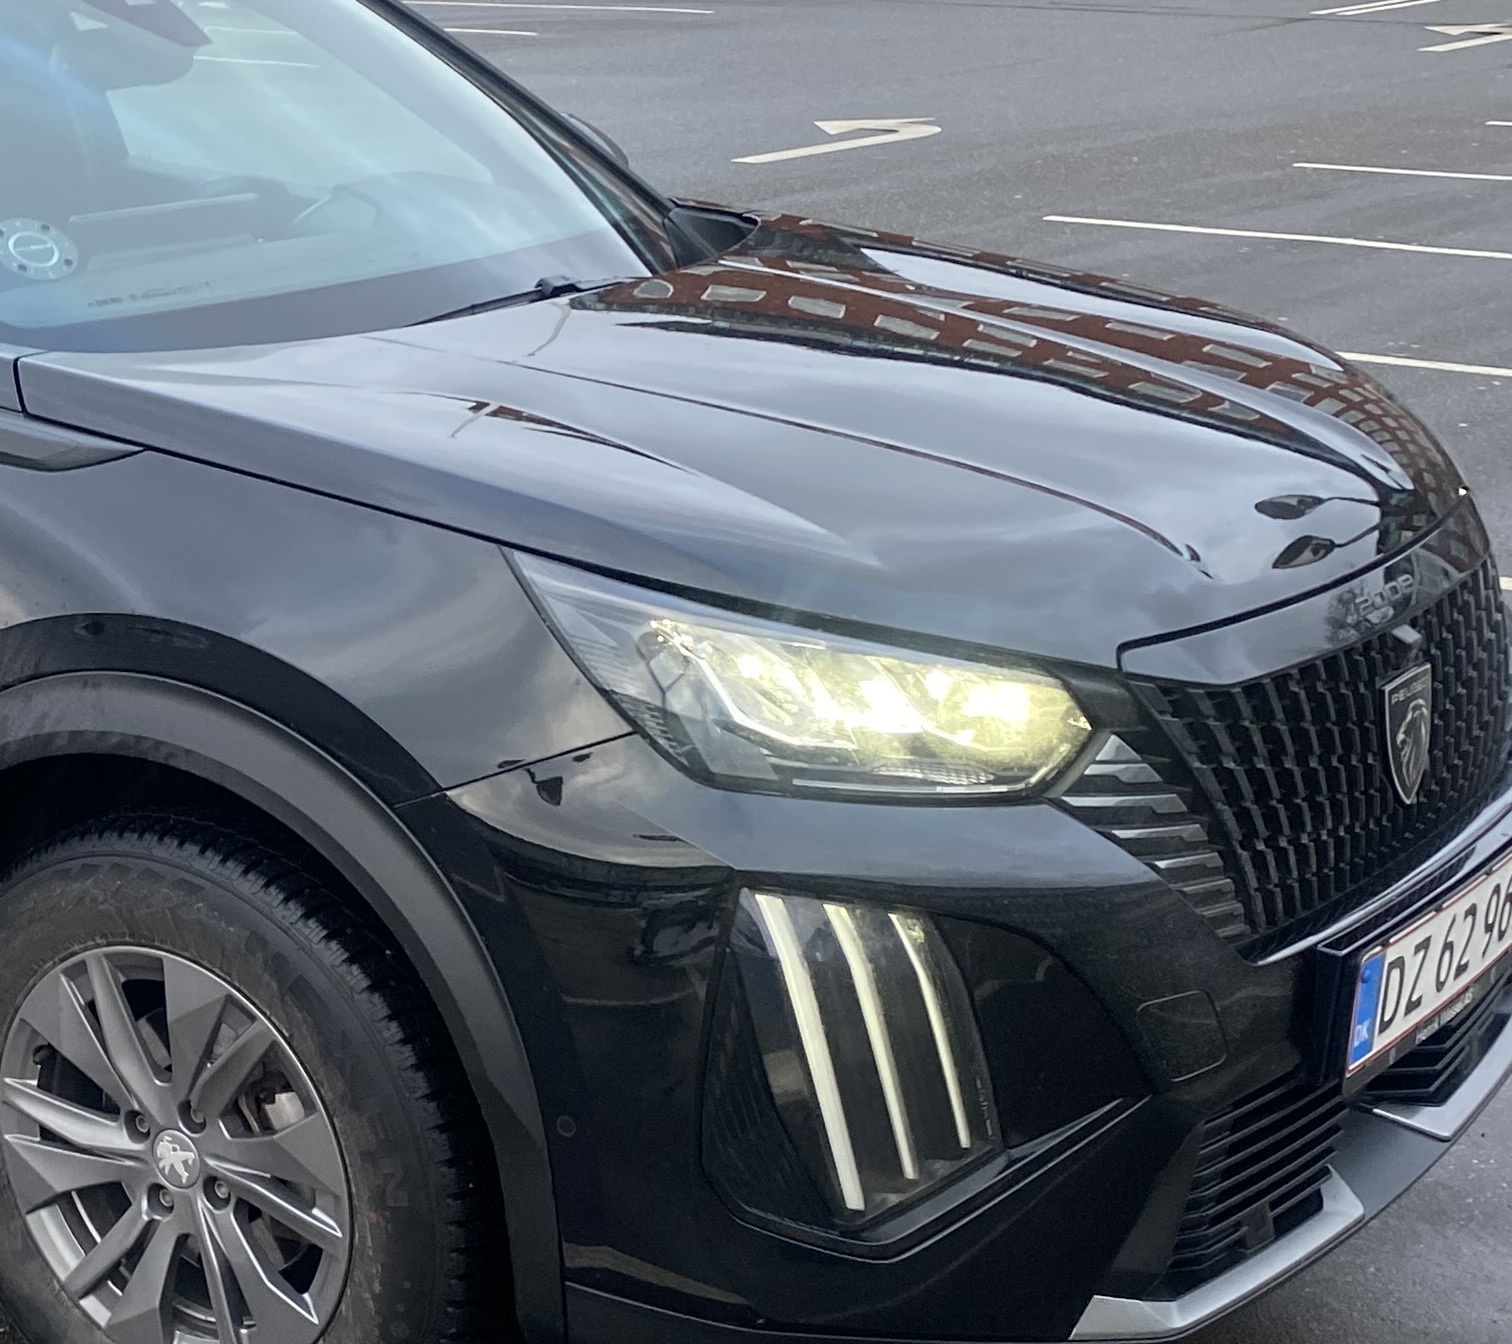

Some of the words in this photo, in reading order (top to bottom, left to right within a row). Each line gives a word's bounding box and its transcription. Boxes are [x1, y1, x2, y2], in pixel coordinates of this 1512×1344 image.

[1378, 934, 1432, 1036] DZ
[1435, 902, 1477, 993] 62
[1354, 1019, 1370, 1048] DK
